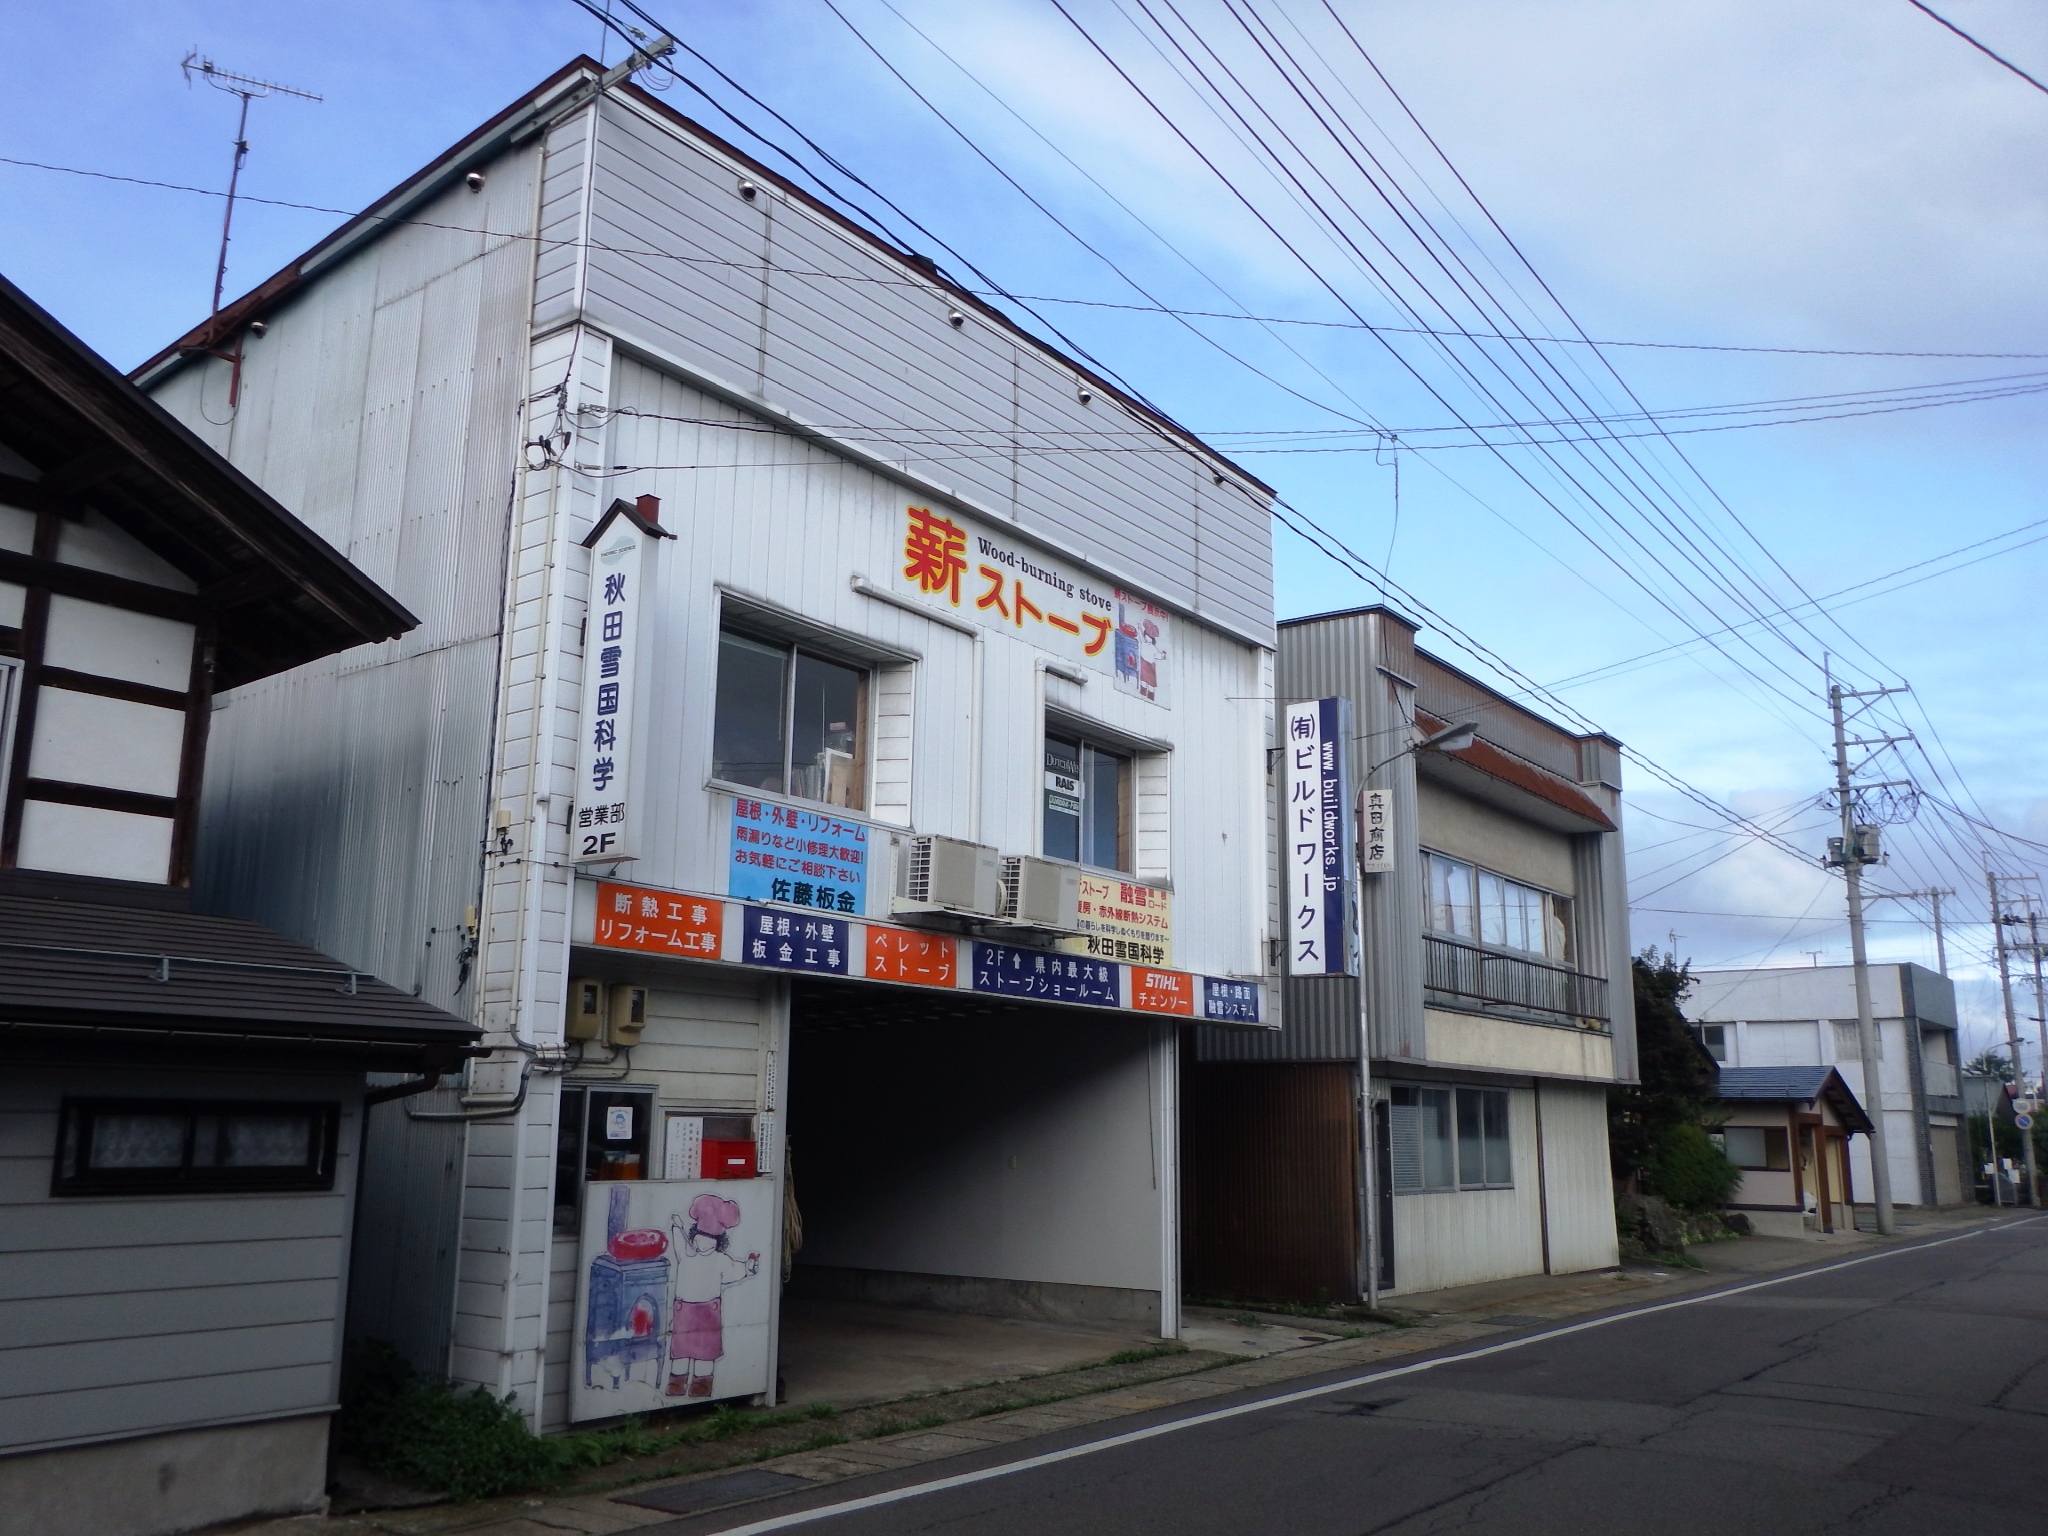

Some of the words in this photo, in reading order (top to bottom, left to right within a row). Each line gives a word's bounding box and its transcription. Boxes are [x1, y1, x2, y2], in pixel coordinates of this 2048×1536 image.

[904, 505, 1113, 657] 薪ストーブ
[977, 536, 1074, 598] Wood-burning
[1079, 588, 1112, 612] stove
[593, 572, 626, 792] 秋田雪国科学
[1056, 776, 1075, 791] RAIS
[579, 802, 625, 829] 営業部
[736, 798, 866, 842] 屋根・外壁・リフォーム
[1322, 741, 1340, 893] www.buildworks.jp
[1368, 792, 1385, 861] 真田商店
[582, 833, 616, 855] 2F
[736, 826, 864, 865] 雨漏りなど小修理大歓迎!
[735, 849, 861, 883] お気軽にご相談下さい
[771, 877, 855, 914] 佐藤板金
[1080, 875, 1109, 899] ストーブ
[1120, 882, 1147, 907] 融雪
[1148, 900, 1167, 911] ロード
[615, 892, 708, 926] 断熱工事
[600, 919, 716, 953] リフォーム工事
[759, 915, 835, 943] 屋根・外壁
[752, 939, 841, 968] 板金工事
[874, 933, 949, 959] ペレット
[1087, 936, 1164, 965] 秋田雪国科学
[874, 955, 950, 981] ストーブ
[986, 948, 1005, 967] 2F
[1035, 956, 1109, 983] 県内最大級
[979, 970, 1115, 1002] ストーブショールーム
[1146, 973, 1179, 991] STIHL
[1212, 982, 1251, 1000] 屋根・路面
[1138, 992, 1188, 1010] チェンソー
[1208, 1000, 1255, 1018] 融雪システム
